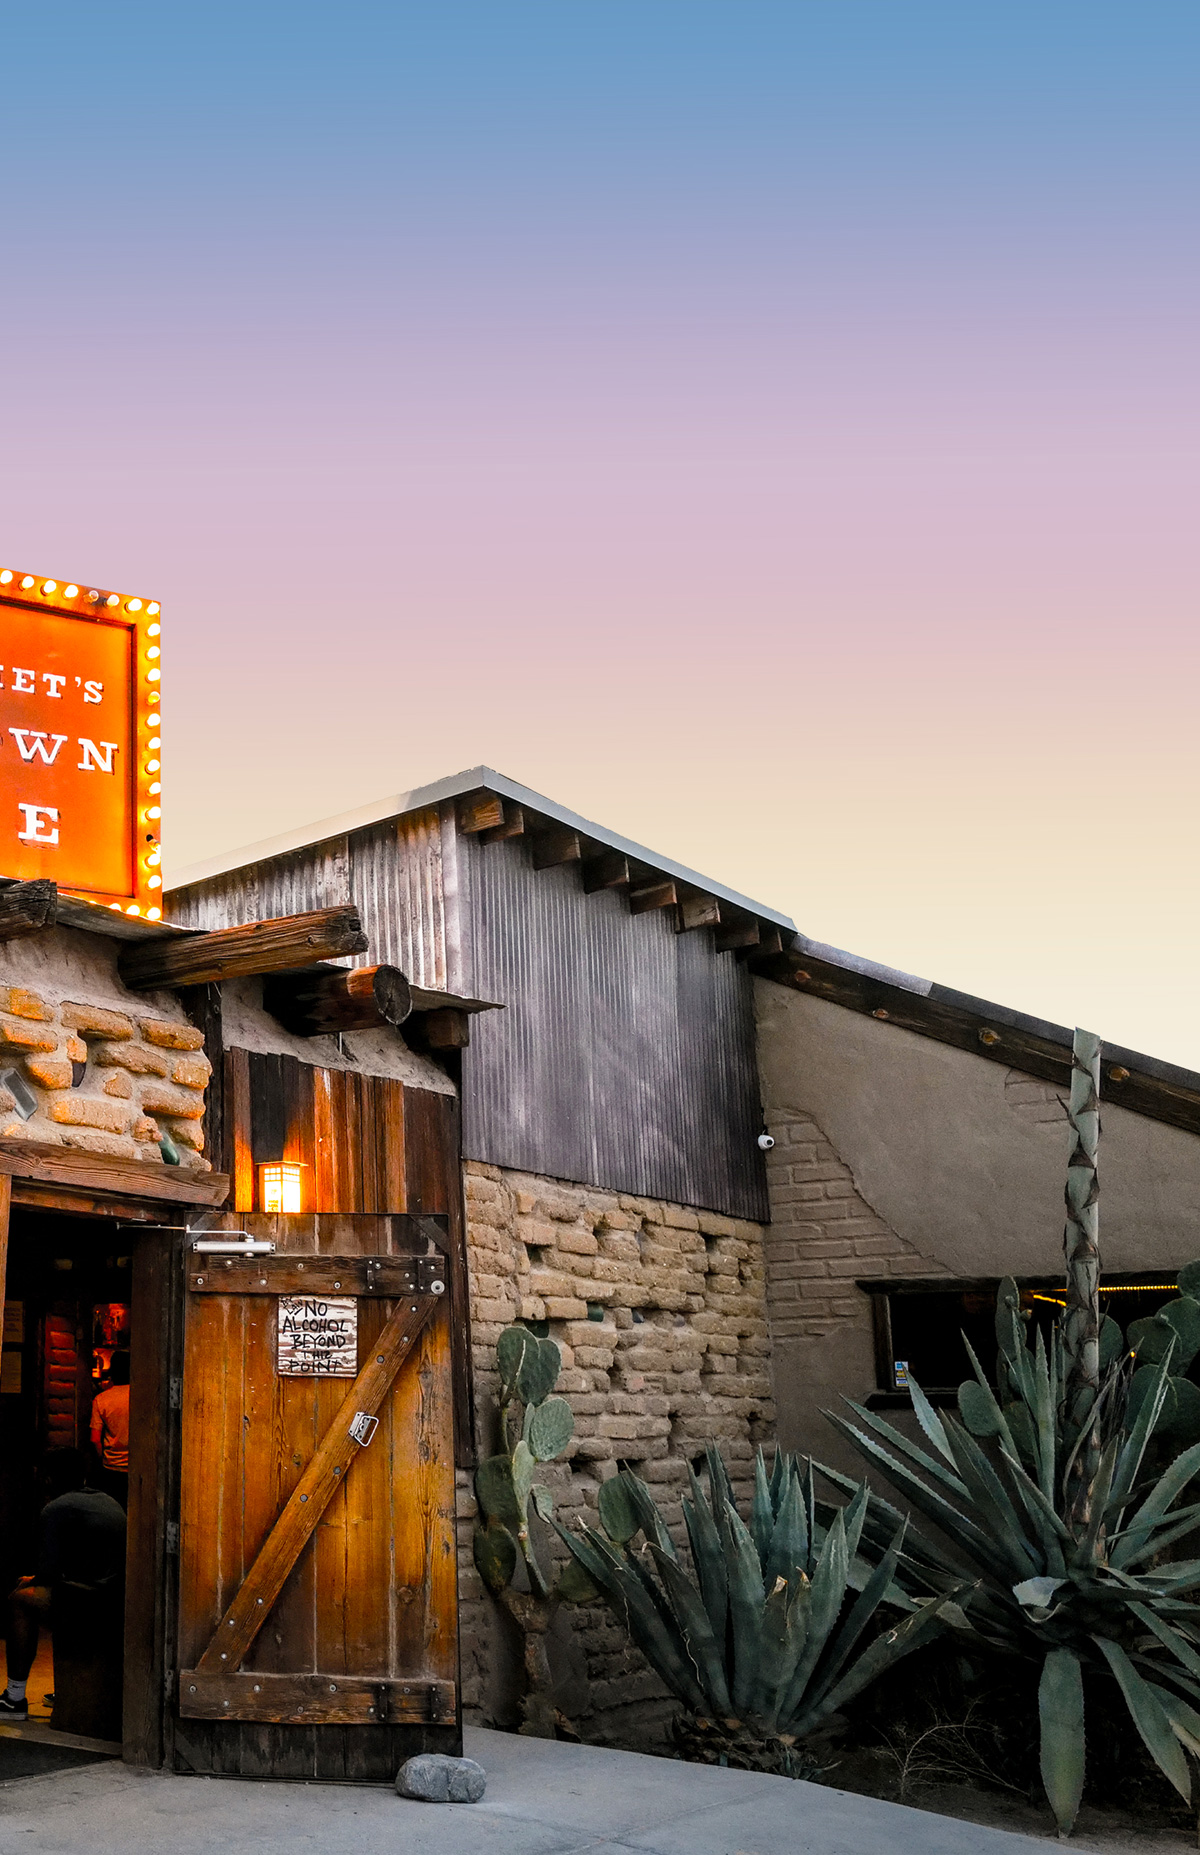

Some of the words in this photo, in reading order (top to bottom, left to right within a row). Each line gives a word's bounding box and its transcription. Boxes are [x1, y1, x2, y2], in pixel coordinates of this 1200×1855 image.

[304, 1299, 328, 1318] NO
[282, 1316, 348, 1334] ALCOHOL
[289, 1333, 346, 1350] BEYOND
[301, 1350, 333, 1360] THIS
[288, 1359, 341, 1373] POINT
